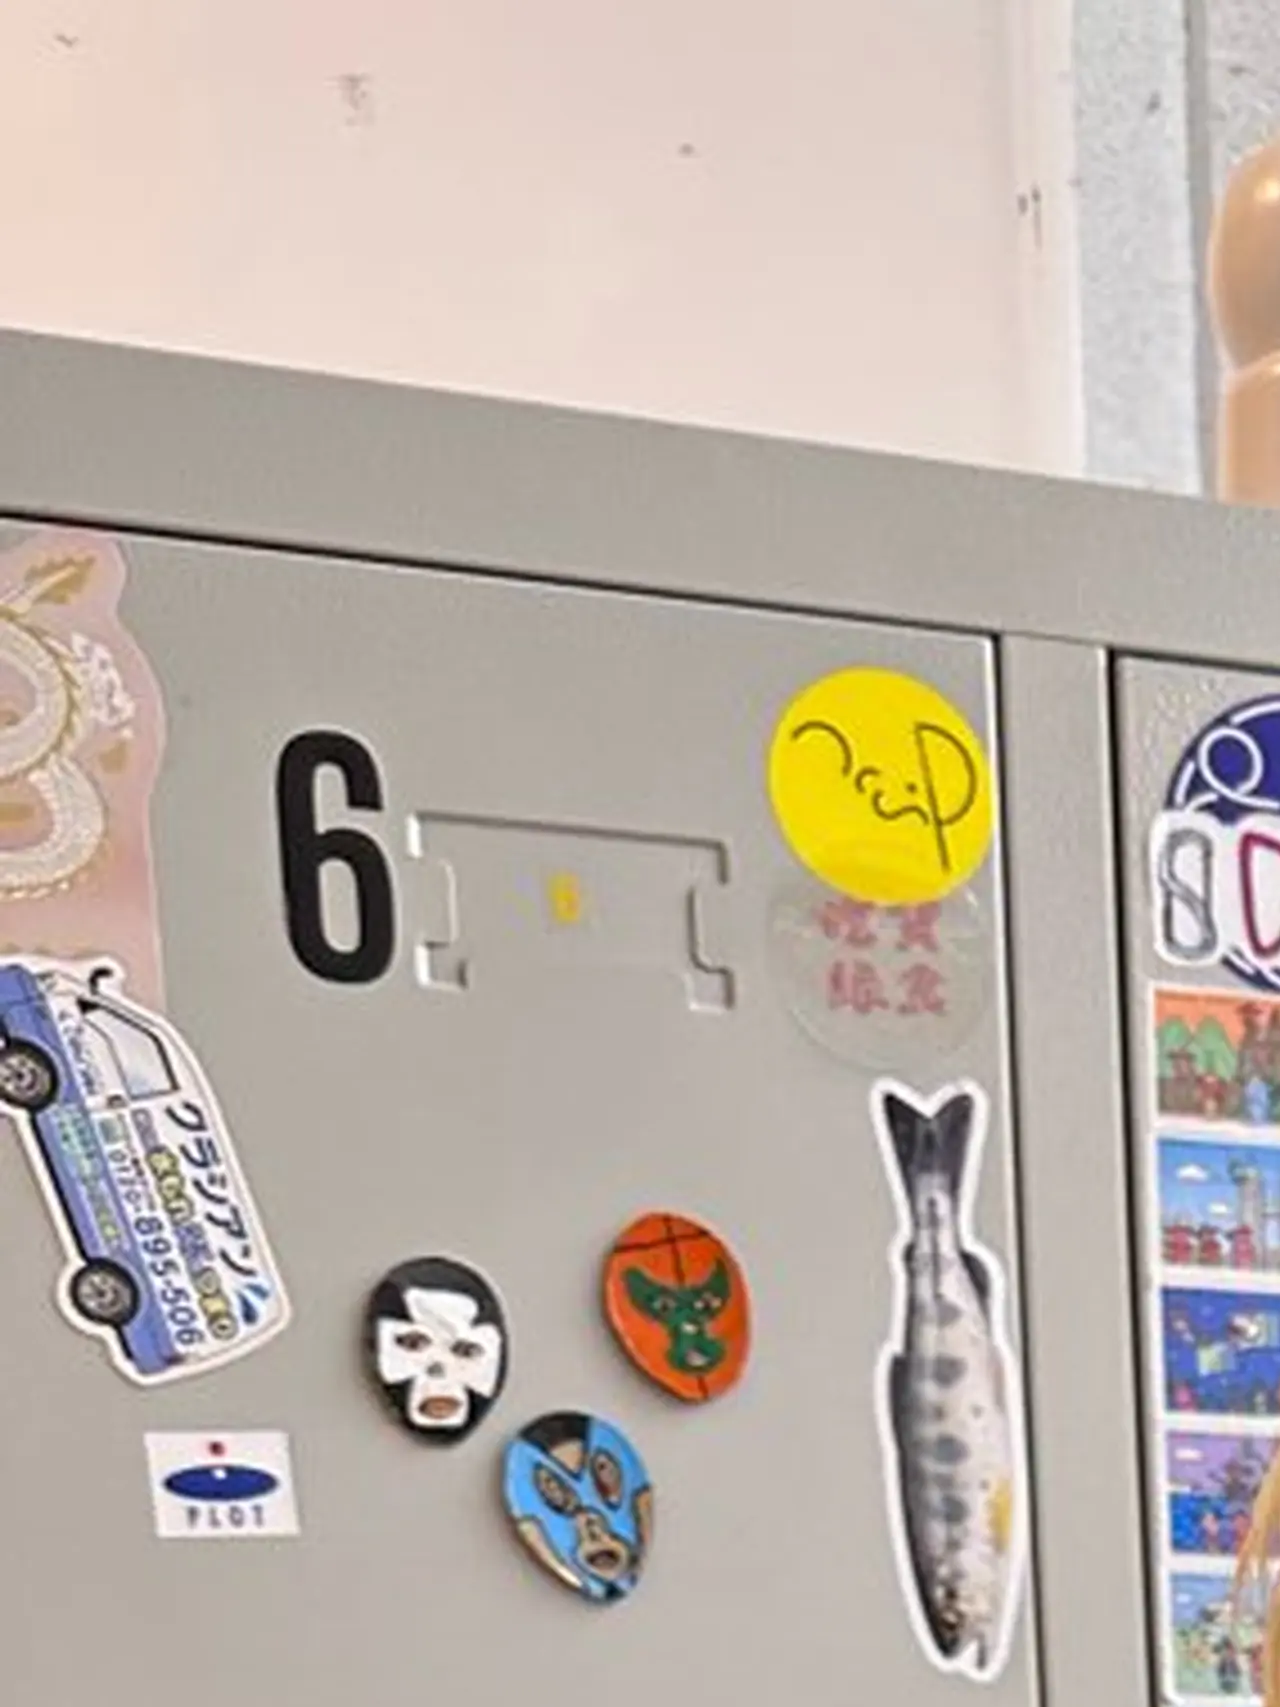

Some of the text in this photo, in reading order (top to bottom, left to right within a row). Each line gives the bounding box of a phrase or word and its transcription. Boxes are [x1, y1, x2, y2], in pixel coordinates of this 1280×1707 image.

[275, 729, 397, 985] 6
[164, 1100, 260, 1278] クラシアン
